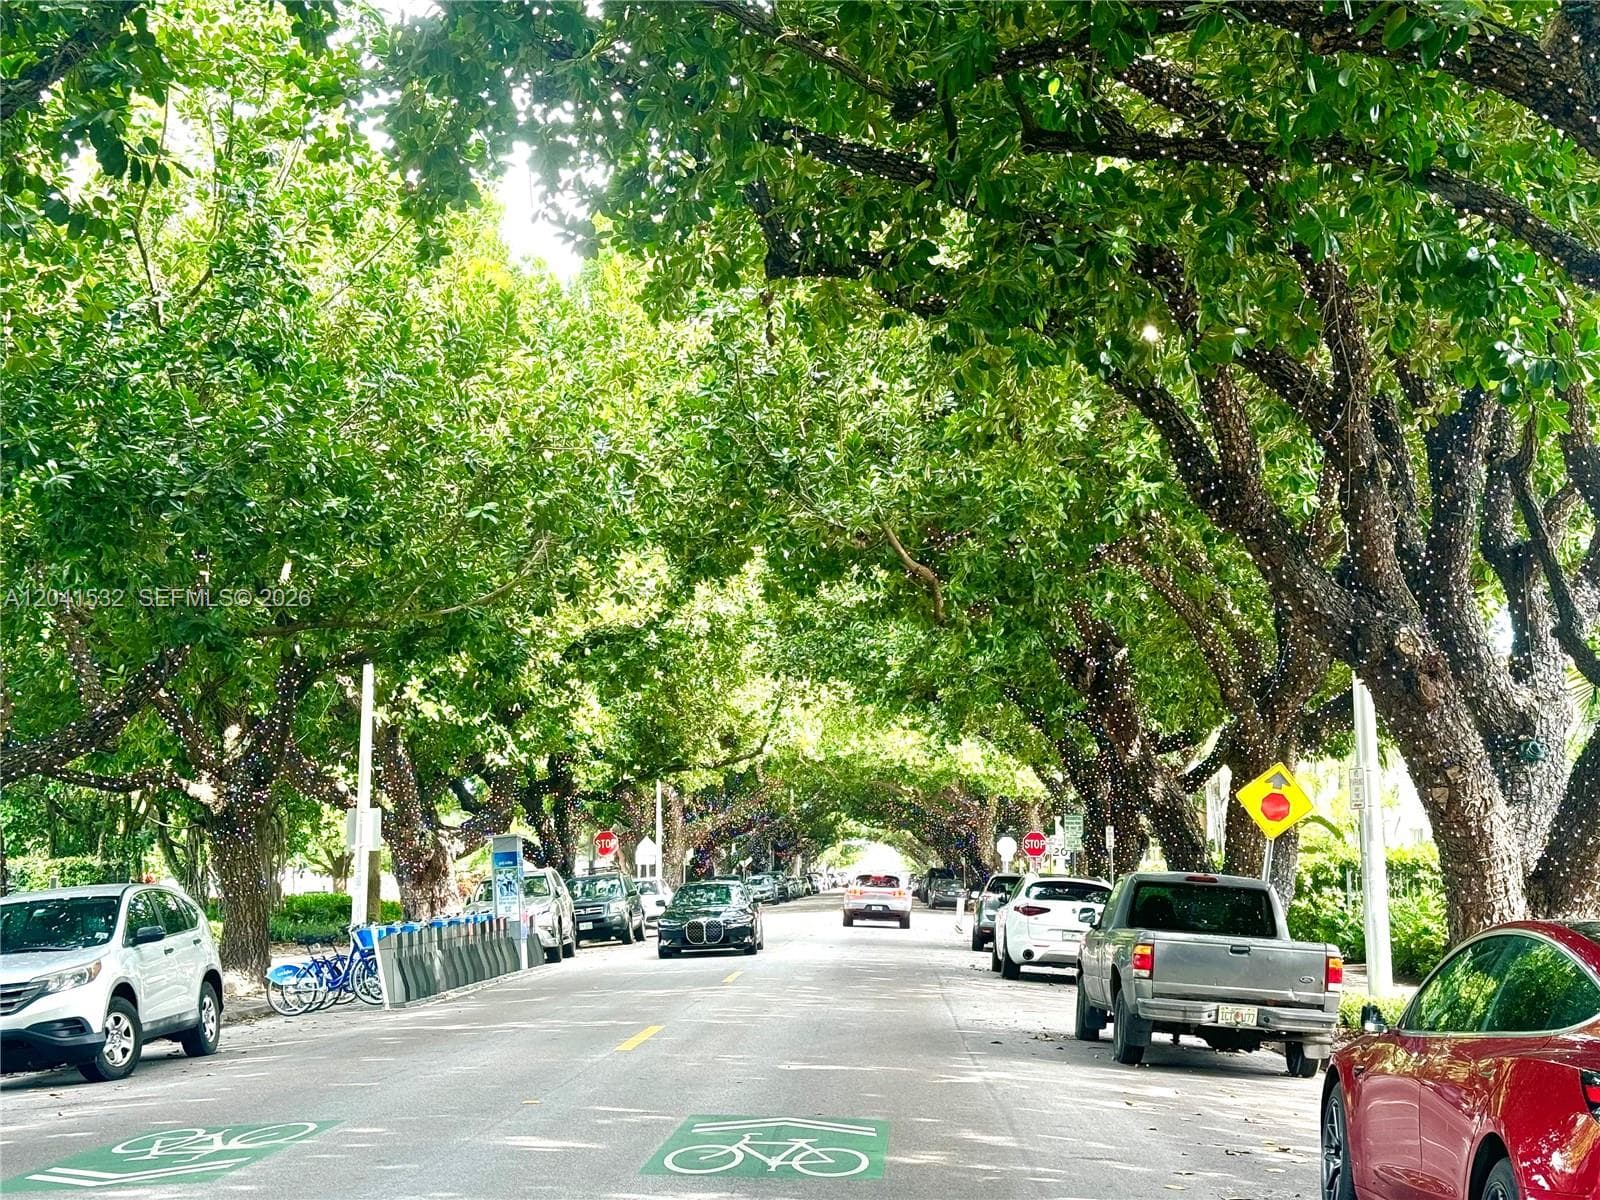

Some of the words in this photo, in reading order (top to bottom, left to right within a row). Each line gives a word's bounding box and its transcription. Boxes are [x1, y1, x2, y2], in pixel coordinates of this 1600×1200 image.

[595, 839, 617, 849] STOP
[1025, 839, 1046, 849] STOP
[1053, 847, 1068, 857] 20
